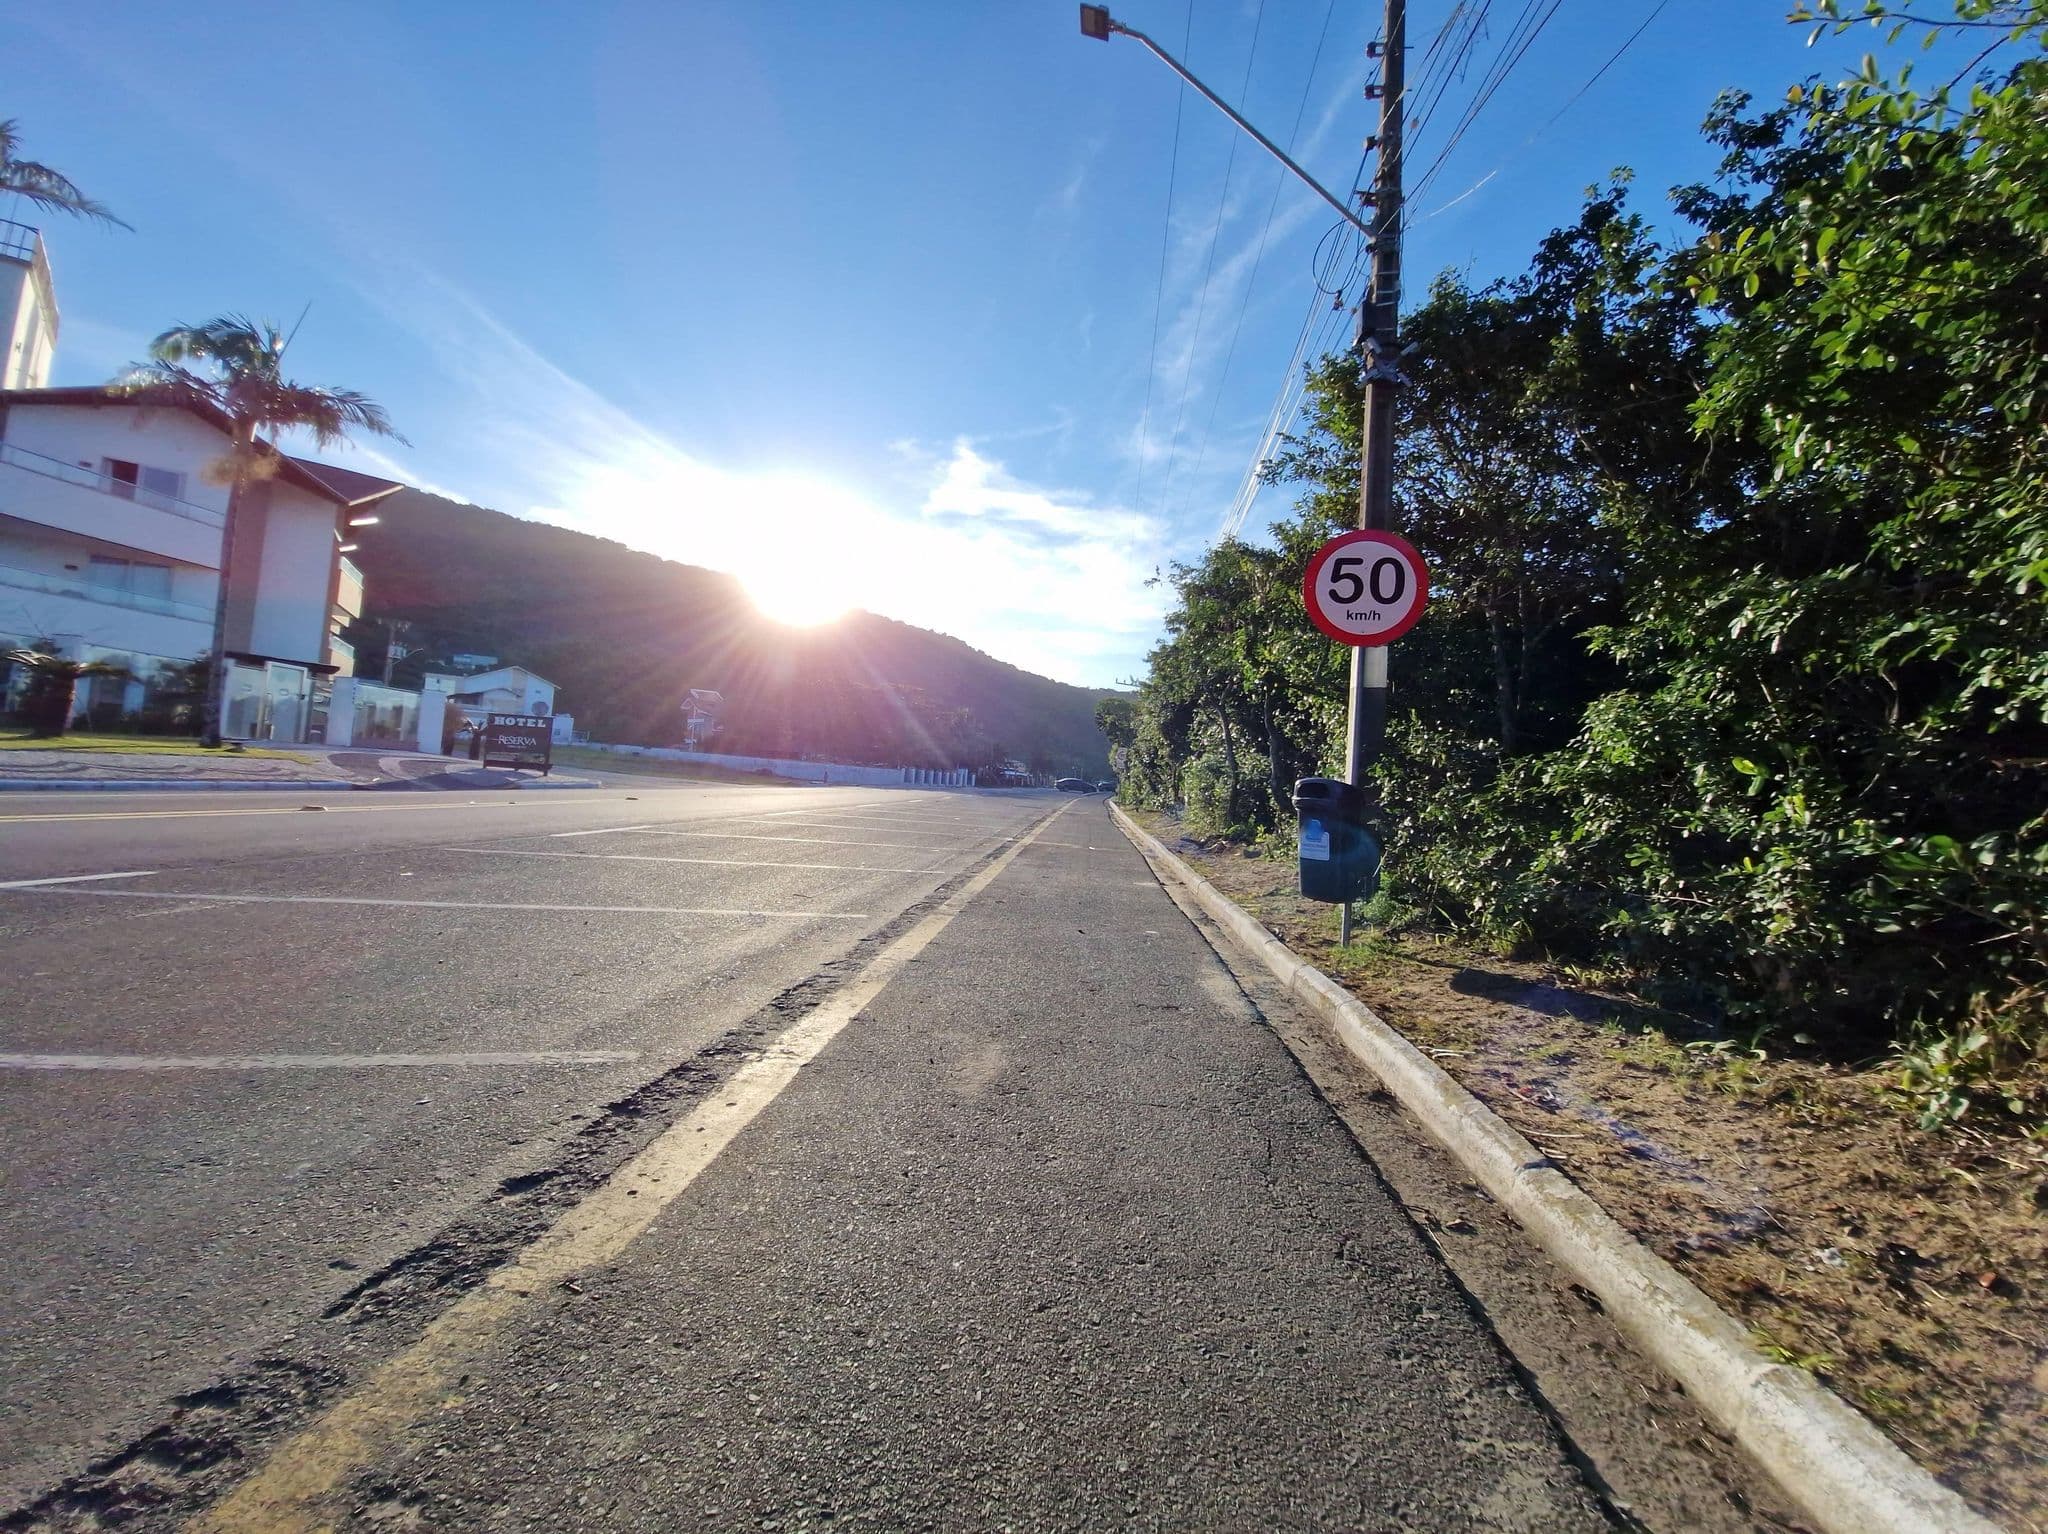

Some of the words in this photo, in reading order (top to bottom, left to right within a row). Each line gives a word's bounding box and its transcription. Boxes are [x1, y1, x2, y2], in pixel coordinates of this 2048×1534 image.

[1328, 557, 1405, 605] 50
[1346, 610, 1381, 620] km/h
[494, 716, 546, 728] HOTEL
